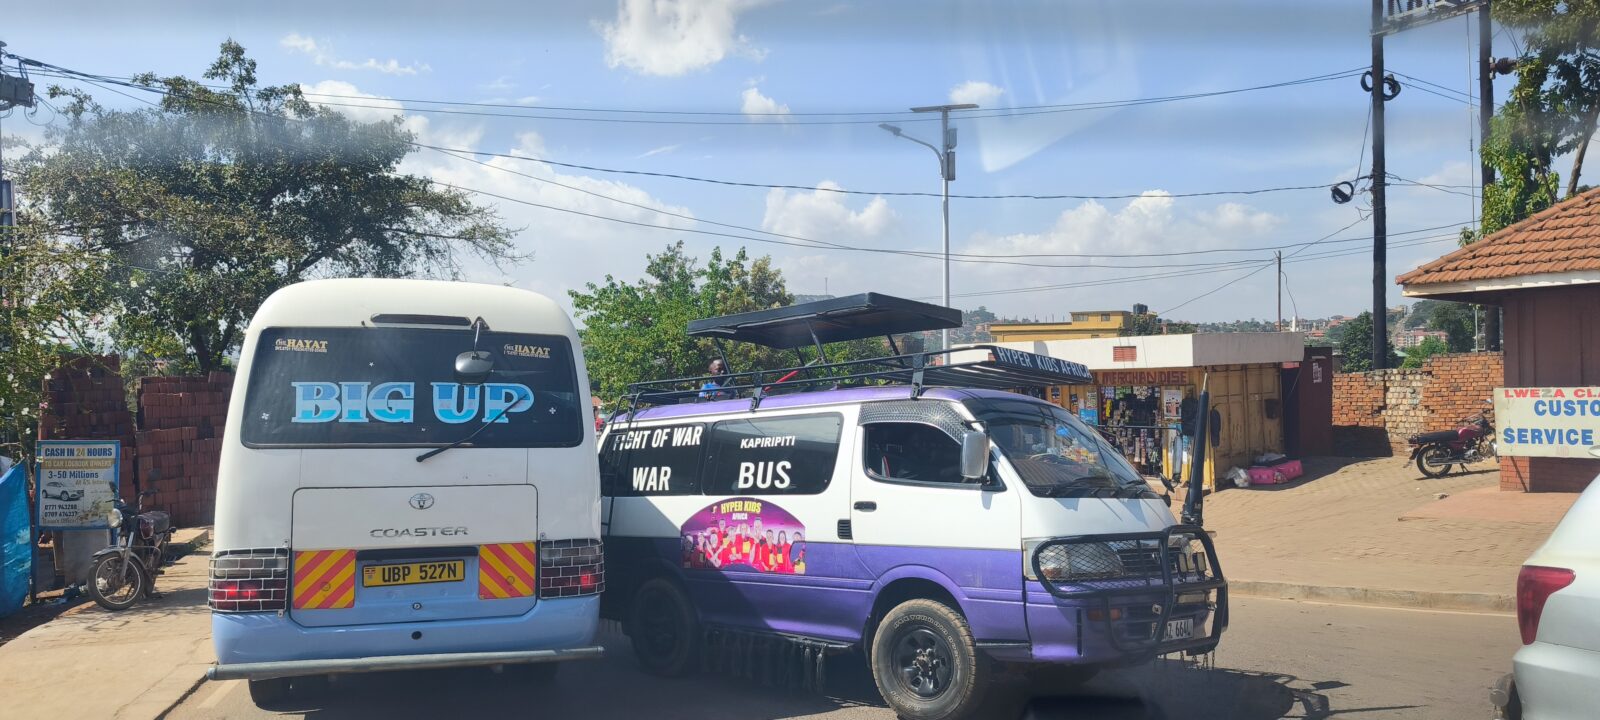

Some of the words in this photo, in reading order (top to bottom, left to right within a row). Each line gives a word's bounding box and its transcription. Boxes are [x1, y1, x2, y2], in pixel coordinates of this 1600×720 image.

[287, 338, 328, 349] HAYAT
[514, 344, 551, 355] HAYAT
[996, 346, 1033, 368] HYPER
[1035, 354, 1060, 373] KIDS
[1060, 360, 1093, 379] AFRICA
[1102, 370, 1187, 385] MERCHANDISE
[1504, 388, 1565, 398] LWEZA
[1573, 388, 1600, 398] CL
[290, 381, 415, 423] BIG
[430, 381, 535, 424] UP
[1534, 399, 1600, 417] CUSTO
[651, 428, 671, 448] OF
[672, 425, 703, 447] WAR
[740, 435, 796, 449] KAPIRIPITI
[1503, 427, 1594, 446] SERVICE
[44, 447, 66, 457] CASH
[66, 447, 75, 457] IN
[76, 447, 86, 457] 24
[87, 447, 113, 457] HOURS
[48, 470, 67, 479] 3-50
[69, 470, 99, 479] Millions
[632, 466, 672, 491] WAR
[737, 460, 792, 489] BUS
[721, 500, 743, 514] HYPER
[744, 501, 762, 514] KIDS
[369, 526, 469, 538] COASTER
[382, 566, 411, 583] UBP
[419, 562, 457, 580] 527N
